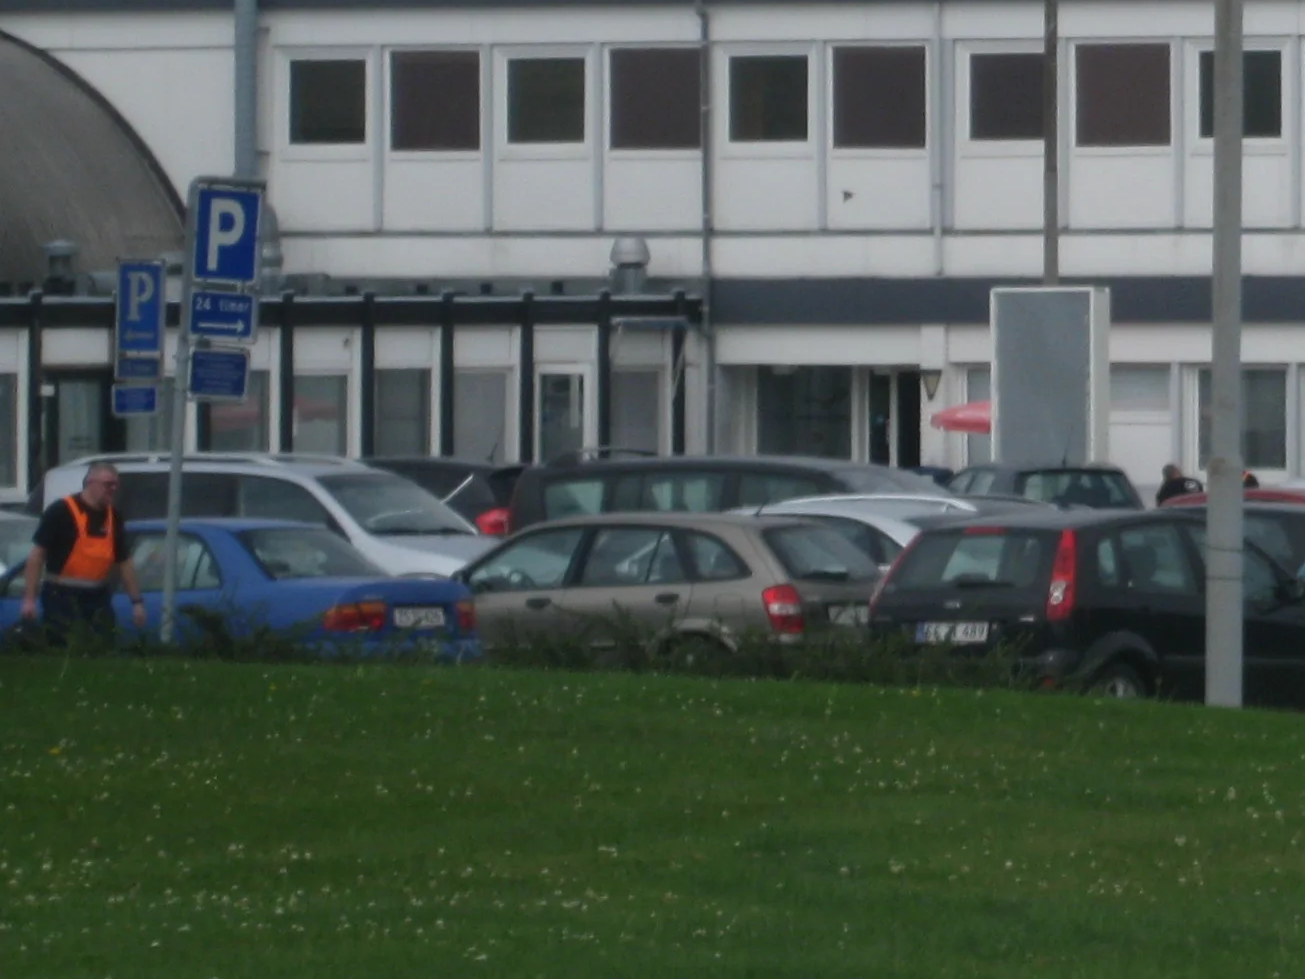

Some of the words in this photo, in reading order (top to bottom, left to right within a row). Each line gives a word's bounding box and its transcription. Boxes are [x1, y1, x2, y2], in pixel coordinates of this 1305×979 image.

[206, 197, 246, 271] P
[127, 271, 155, 322] P
[195, 297, 212, 311] 24
